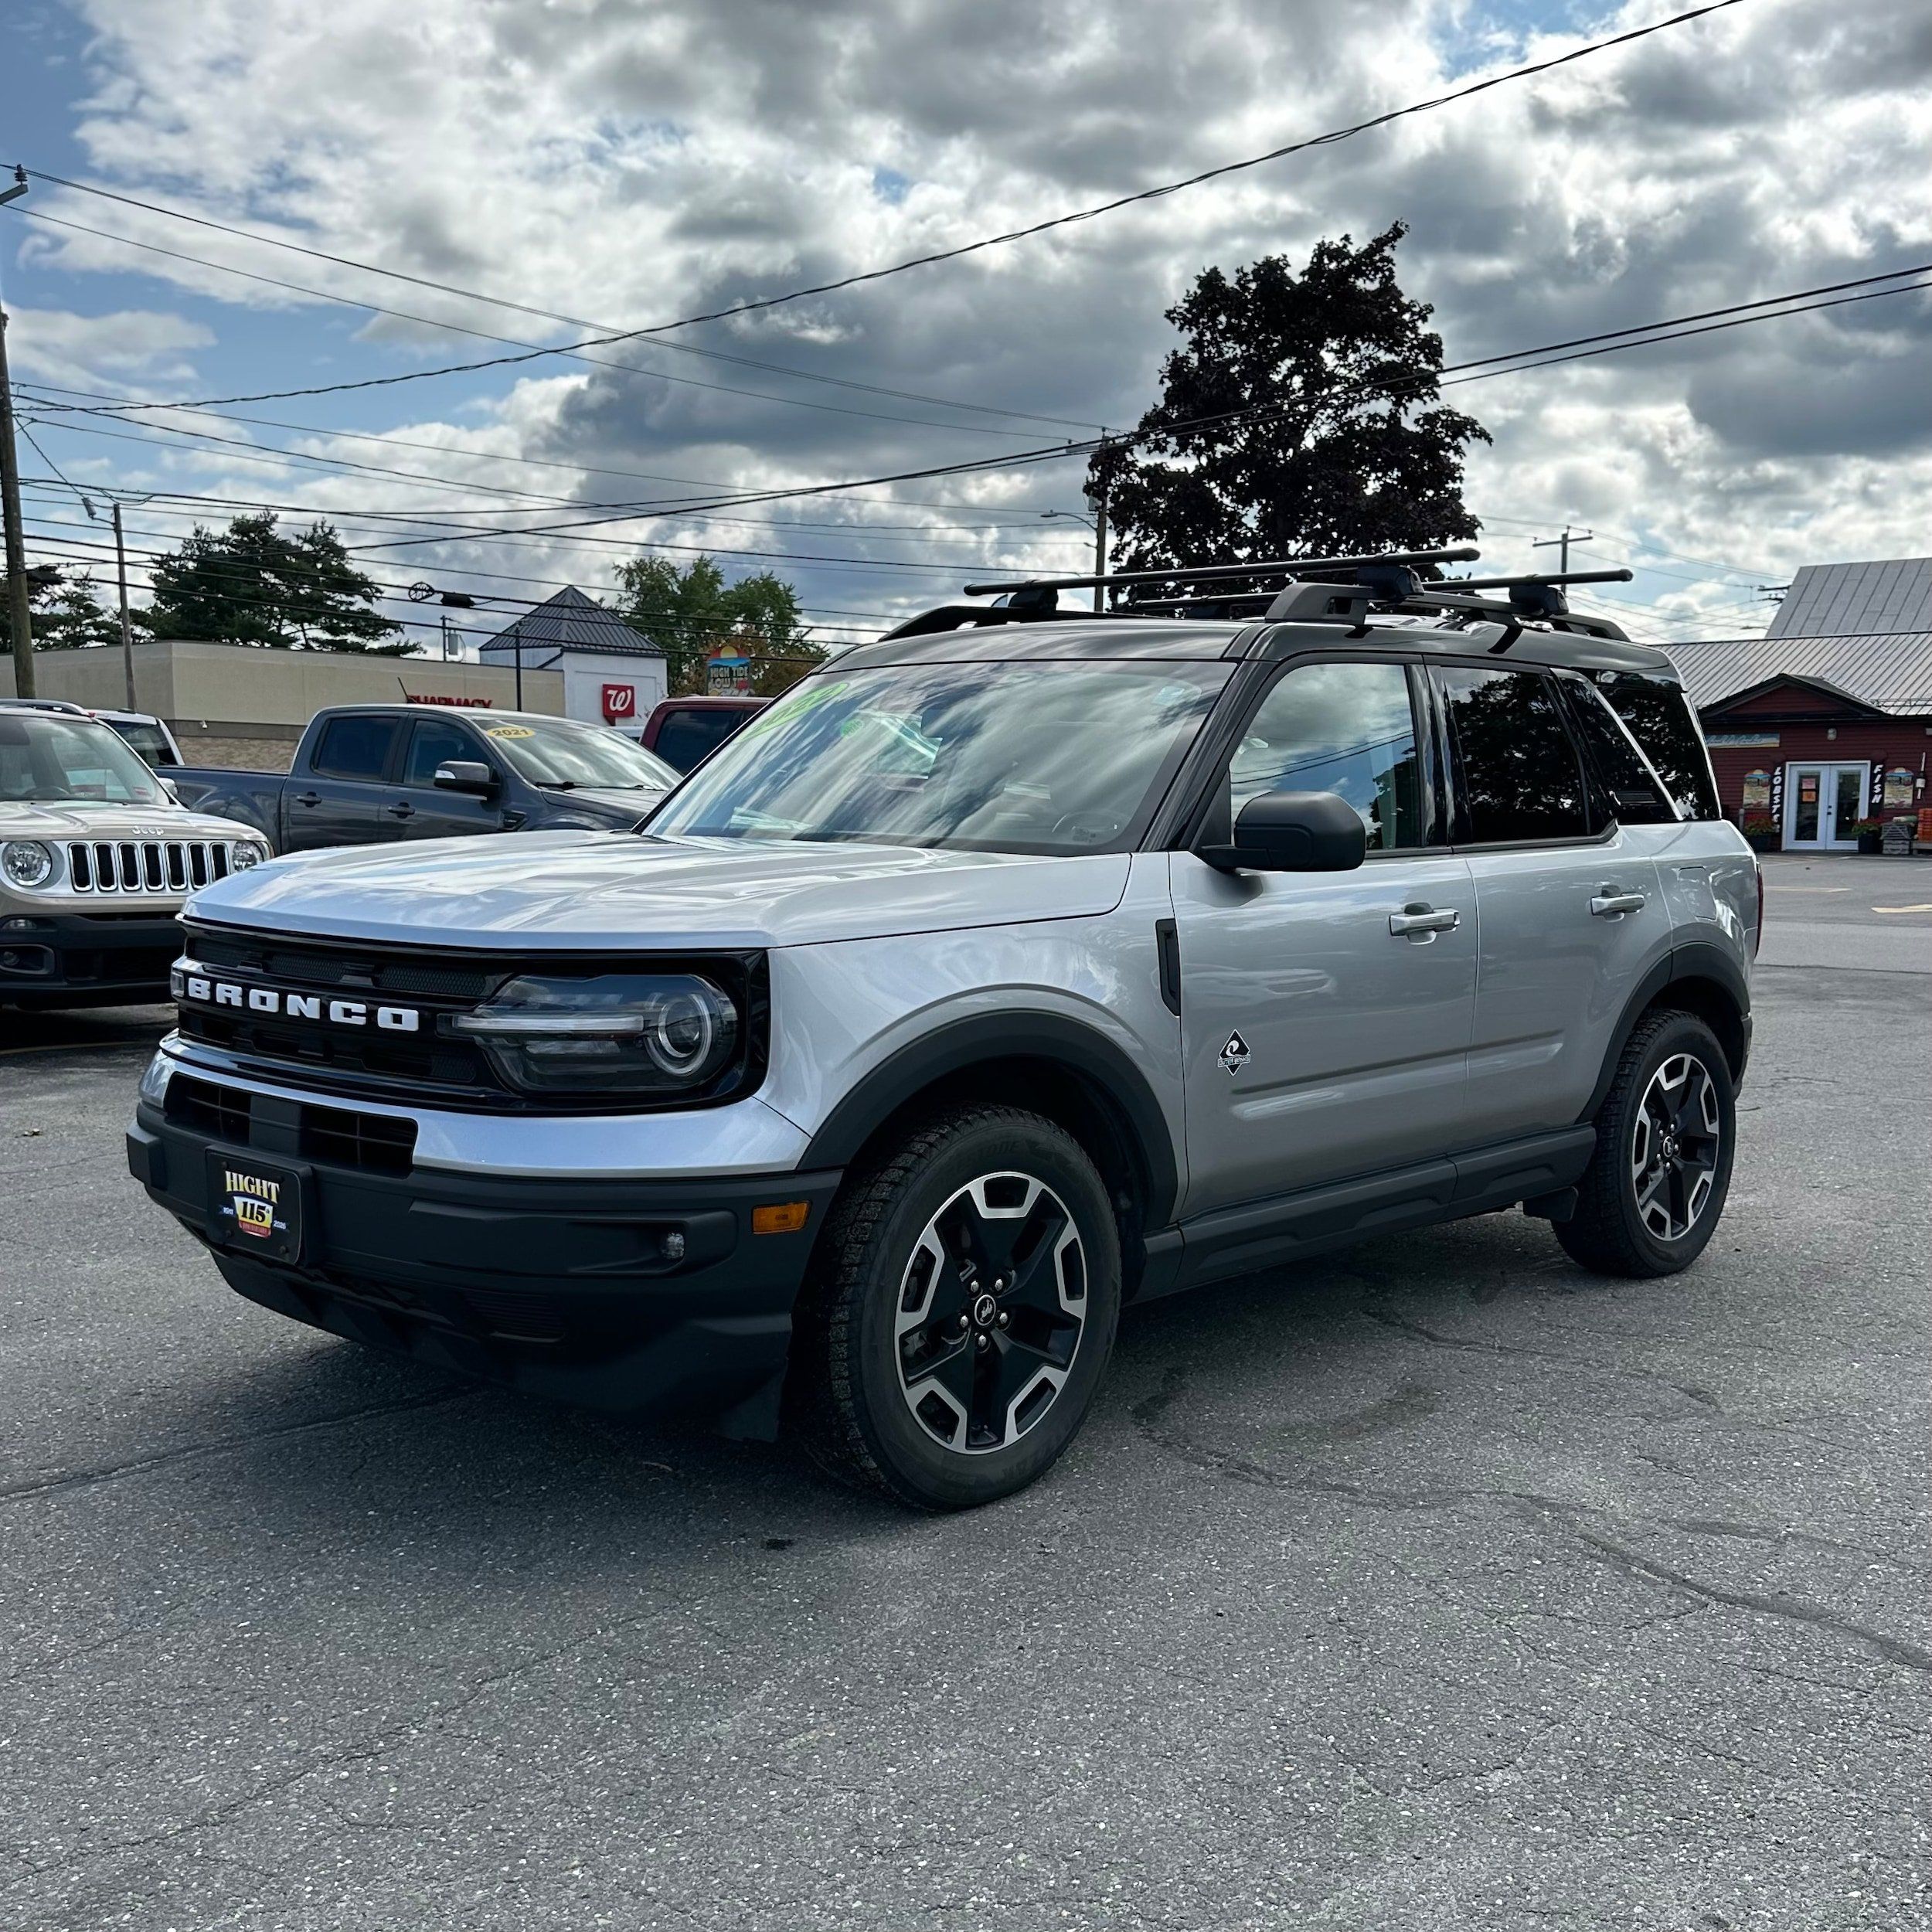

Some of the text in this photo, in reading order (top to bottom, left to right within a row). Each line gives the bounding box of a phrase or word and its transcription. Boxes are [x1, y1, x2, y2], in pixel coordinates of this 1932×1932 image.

[710, 666, 730, 679] HIGH
[492, 727, 529, 737] 2021
[1871, 764, 1884, 804] FISH
[132, 825, 165, 836] Jeep
[188, 977, 420, 1032] BRONCO
[225, 1170, 280, 1204] HIGHT
